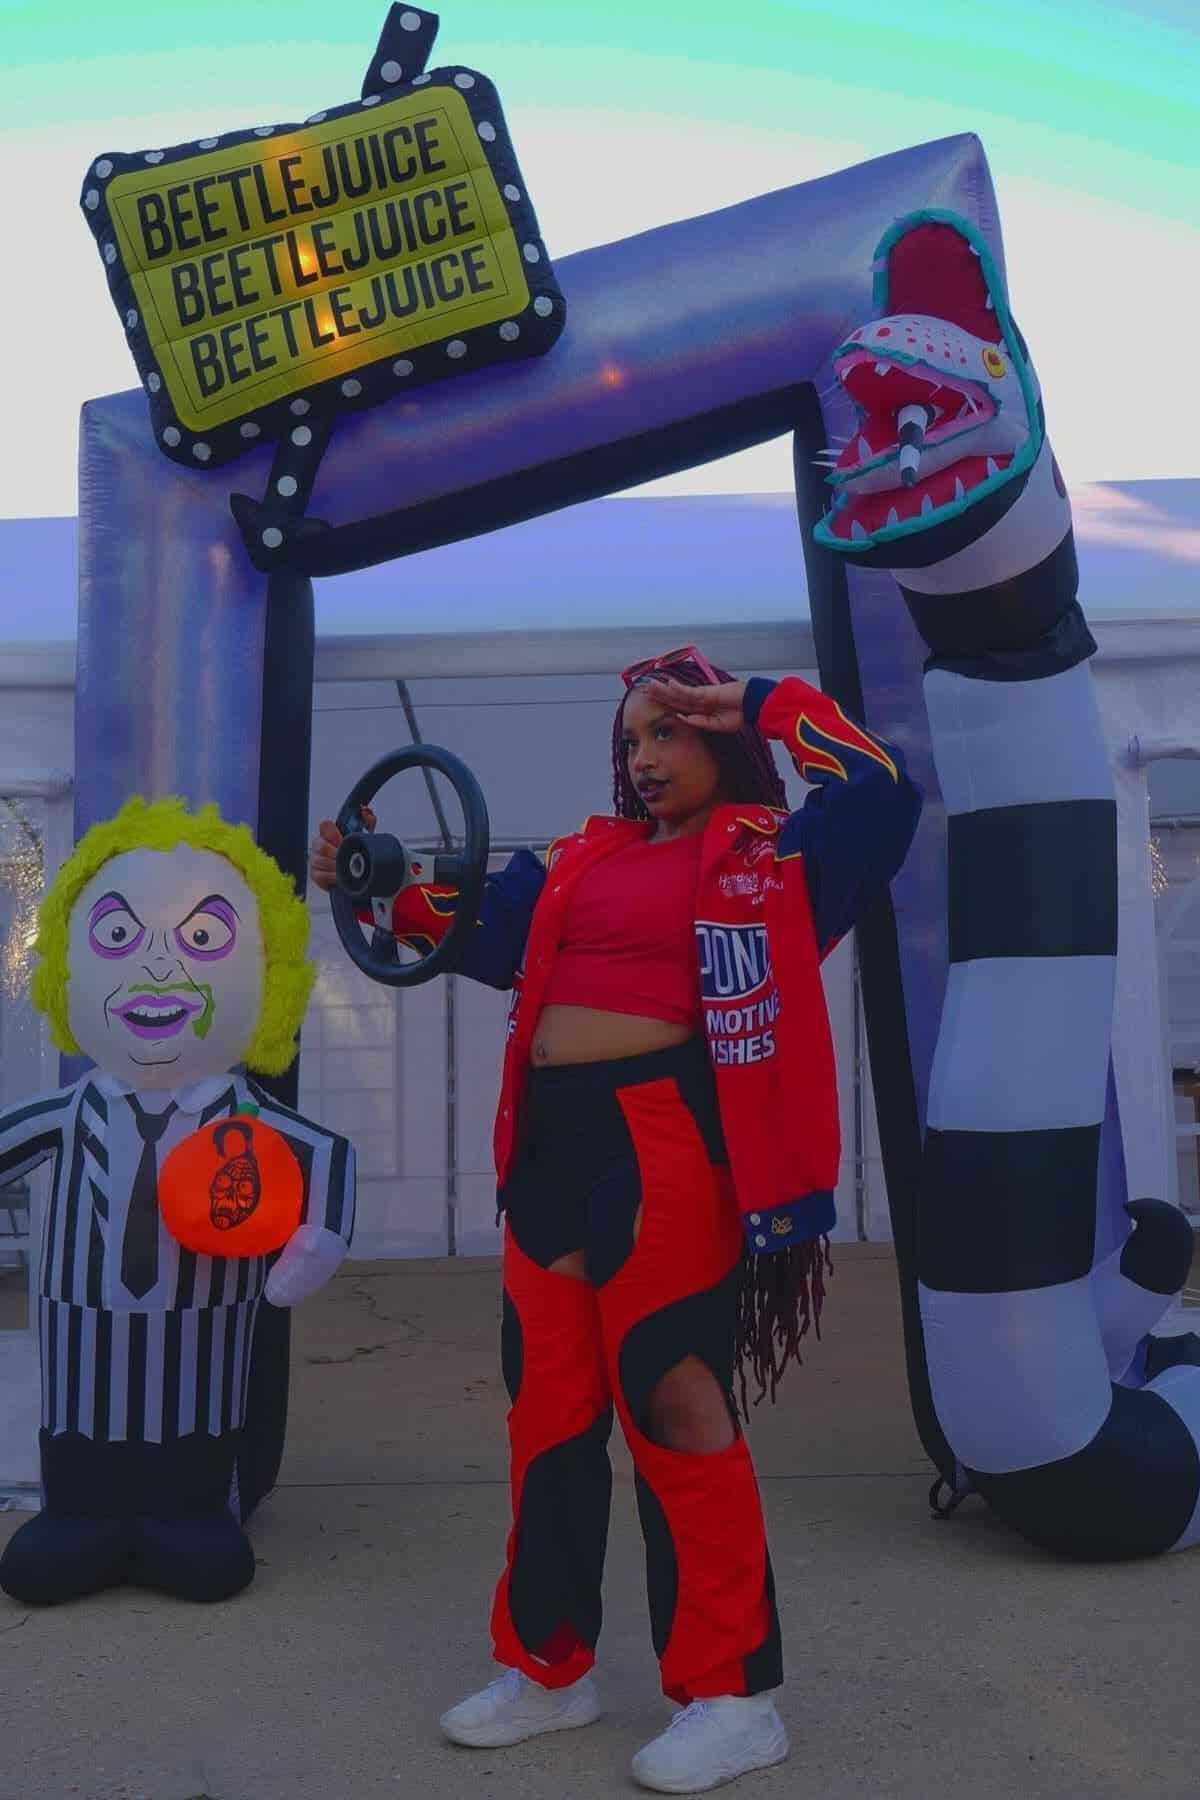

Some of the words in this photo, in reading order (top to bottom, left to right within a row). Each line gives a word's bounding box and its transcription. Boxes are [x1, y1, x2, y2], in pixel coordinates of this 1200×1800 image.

[137, 118, 446, 260] BEETLEJUICE
[171, 181, 476, 328] BEETLEJUICE
[191, 244, 493, 397] BEETLEJUICE
